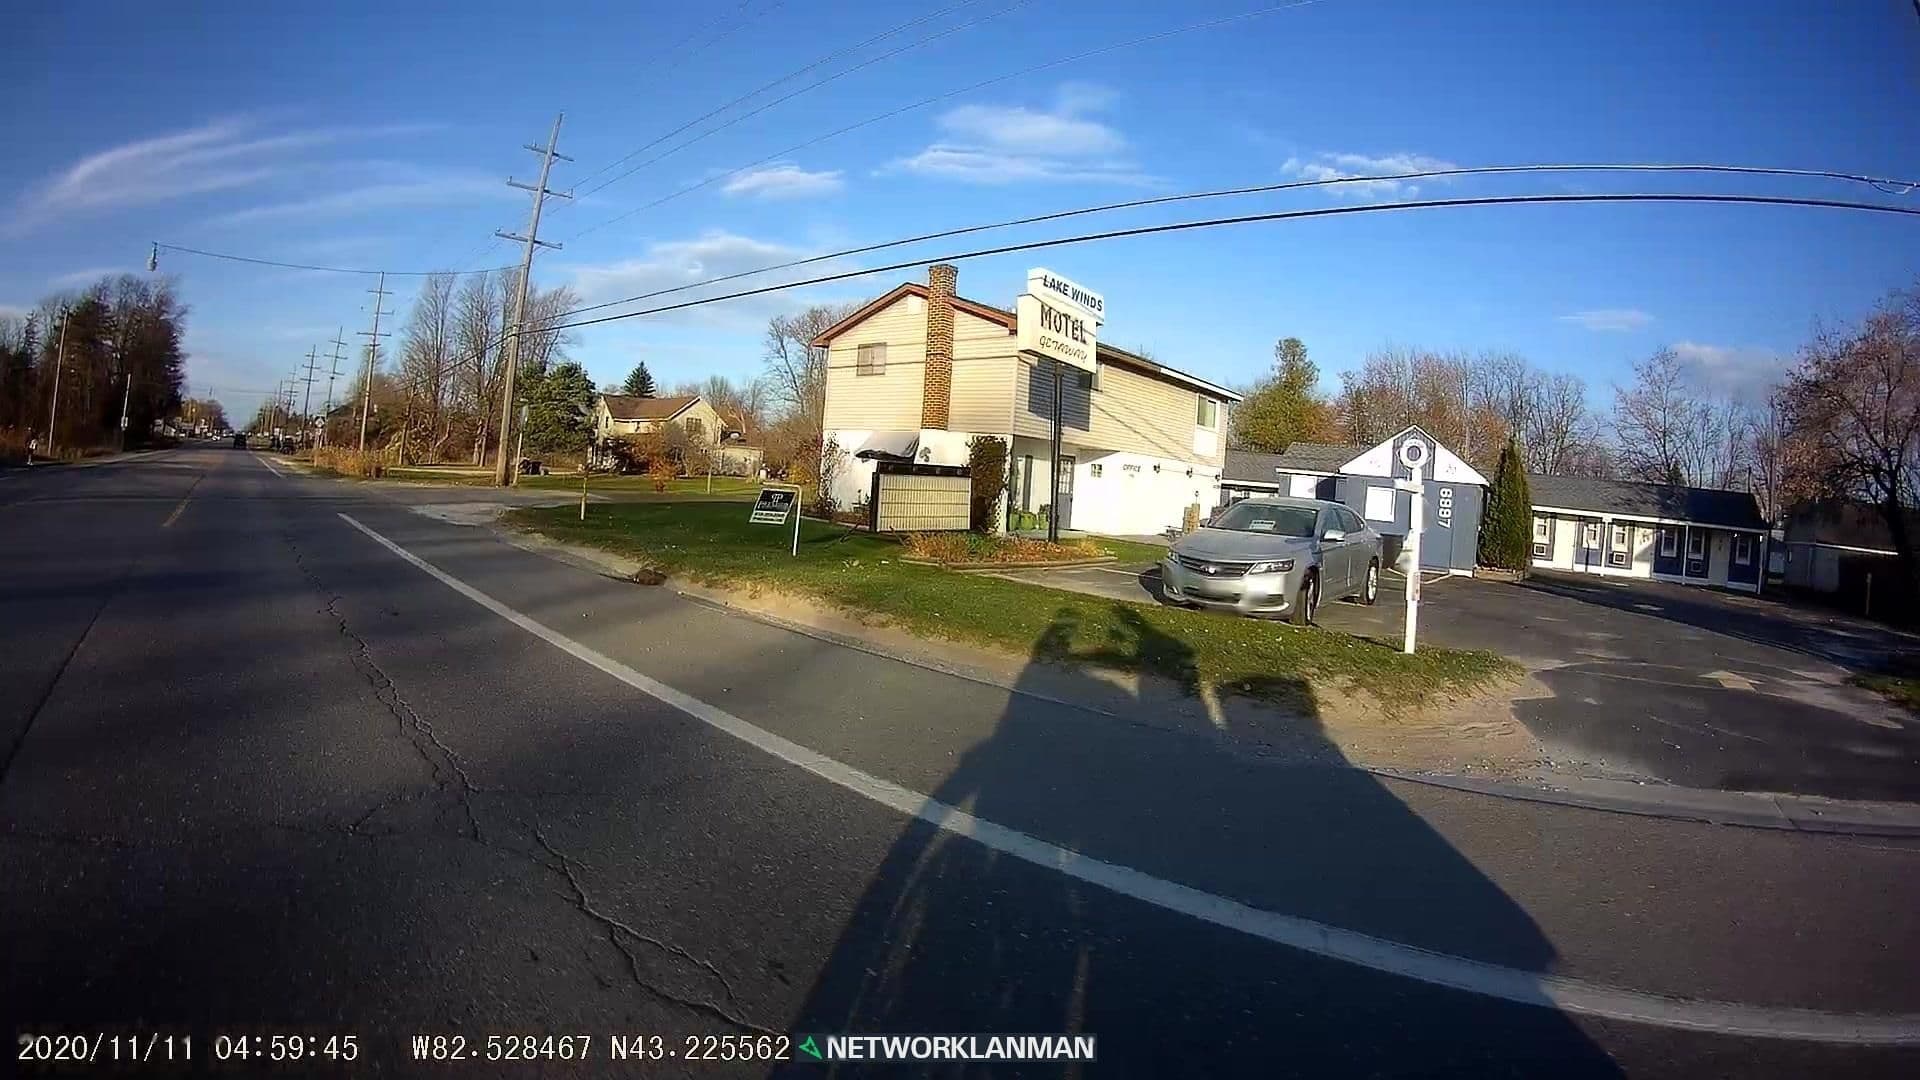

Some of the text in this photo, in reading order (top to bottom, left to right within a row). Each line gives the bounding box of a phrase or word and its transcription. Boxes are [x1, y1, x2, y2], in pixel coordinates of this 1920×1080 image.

[1043, 274, 1103, 312] LAKE WINDS
[1040, 302, 1088, 346] MOTEL
